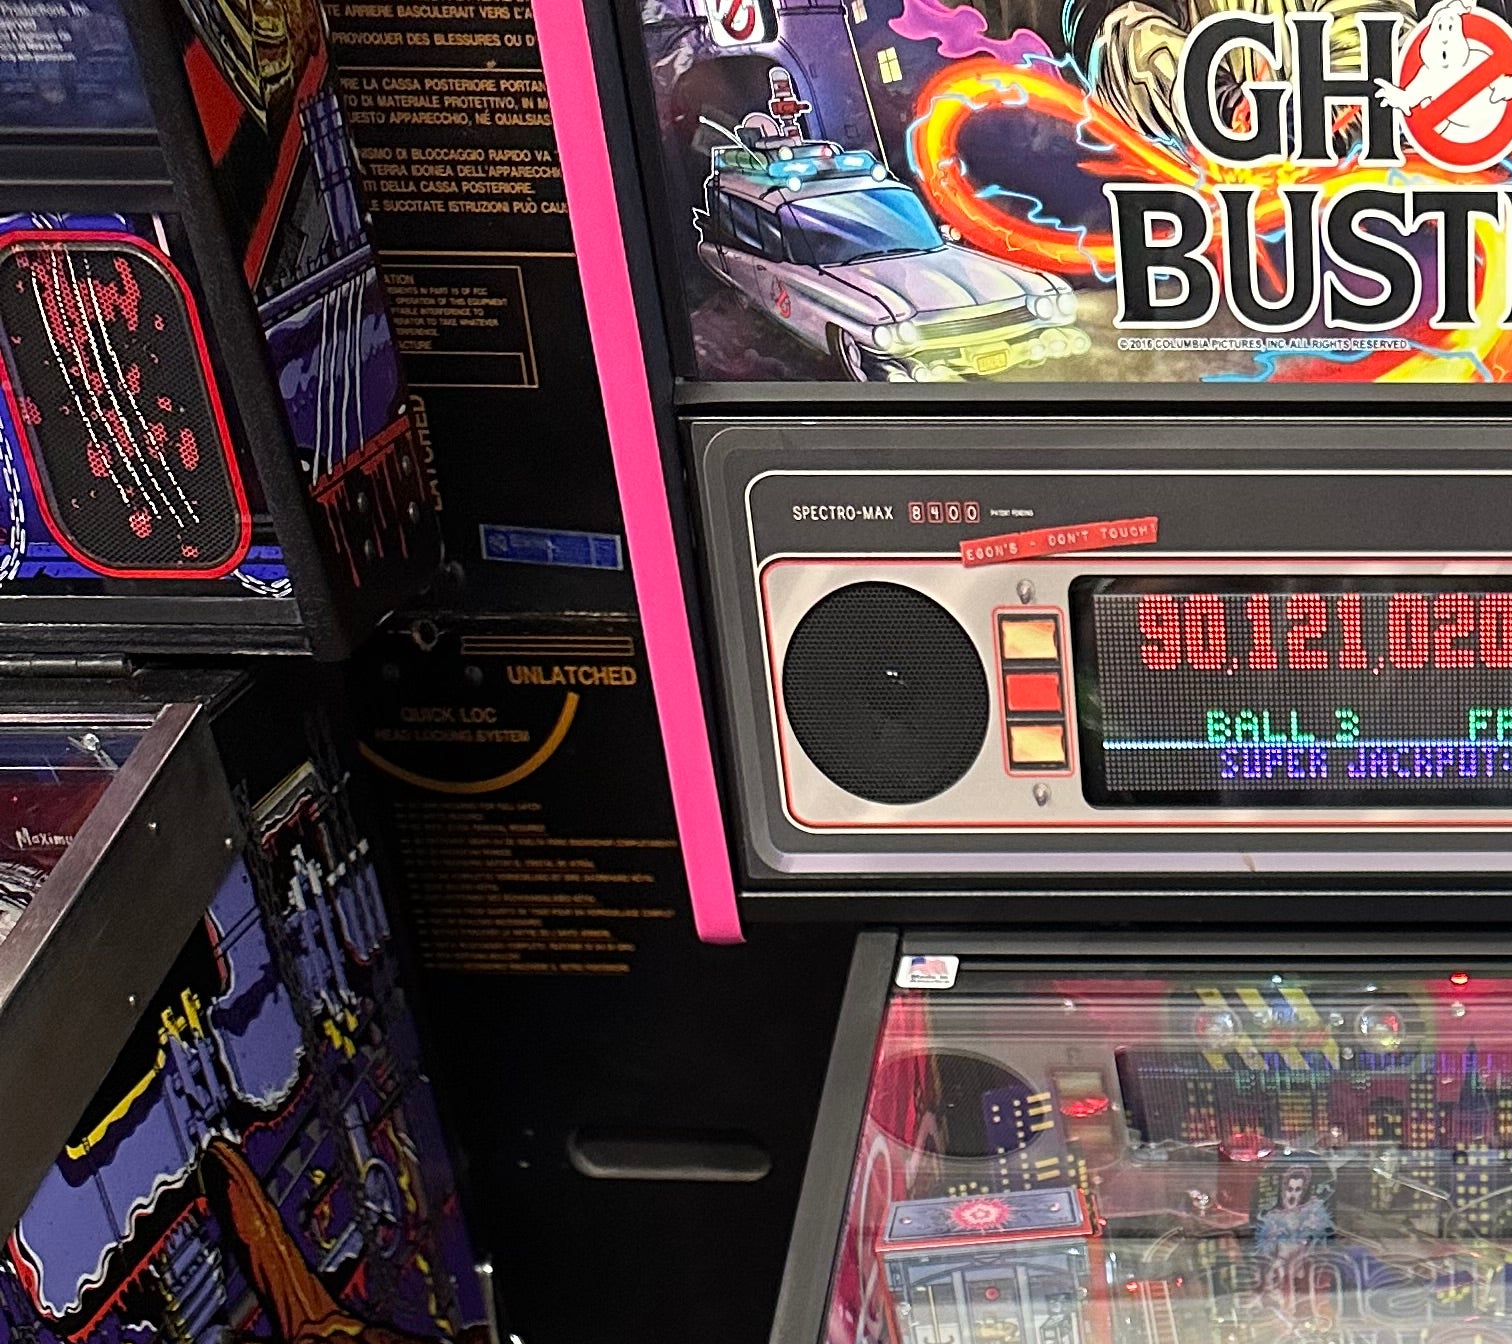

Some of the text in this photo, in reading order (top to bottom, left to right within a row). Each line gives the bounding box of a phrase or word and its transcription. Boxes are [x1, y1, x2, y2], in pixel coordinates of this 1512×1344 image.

[407, 33, 429, 46] DES
[362, 78, 497, 91] LA CASSA POSTERIORE
[381, 181, 458, 193] DELLA CASSA
[1155, 338, 1209, 349] COLUMBIA
[1290, 338, 1309, 349] ALL
[1312, 338, 1349, 349] RIGHTS
[1352, 338, 1407, 349] RESERVED
[792, 505, 893, 520] SPECTRO-MAX
[965, 543, 1018, 561] EGON'S
[1048, 530, 1089, 546] DON'T
[507, 665, 637, 686] UNLATCHED
[1206, 709, 1360, 742] BALL 3
[1220, 748, 1328, 778] SUPER
[1348, 747, 1512, 778] JACKPOT:
